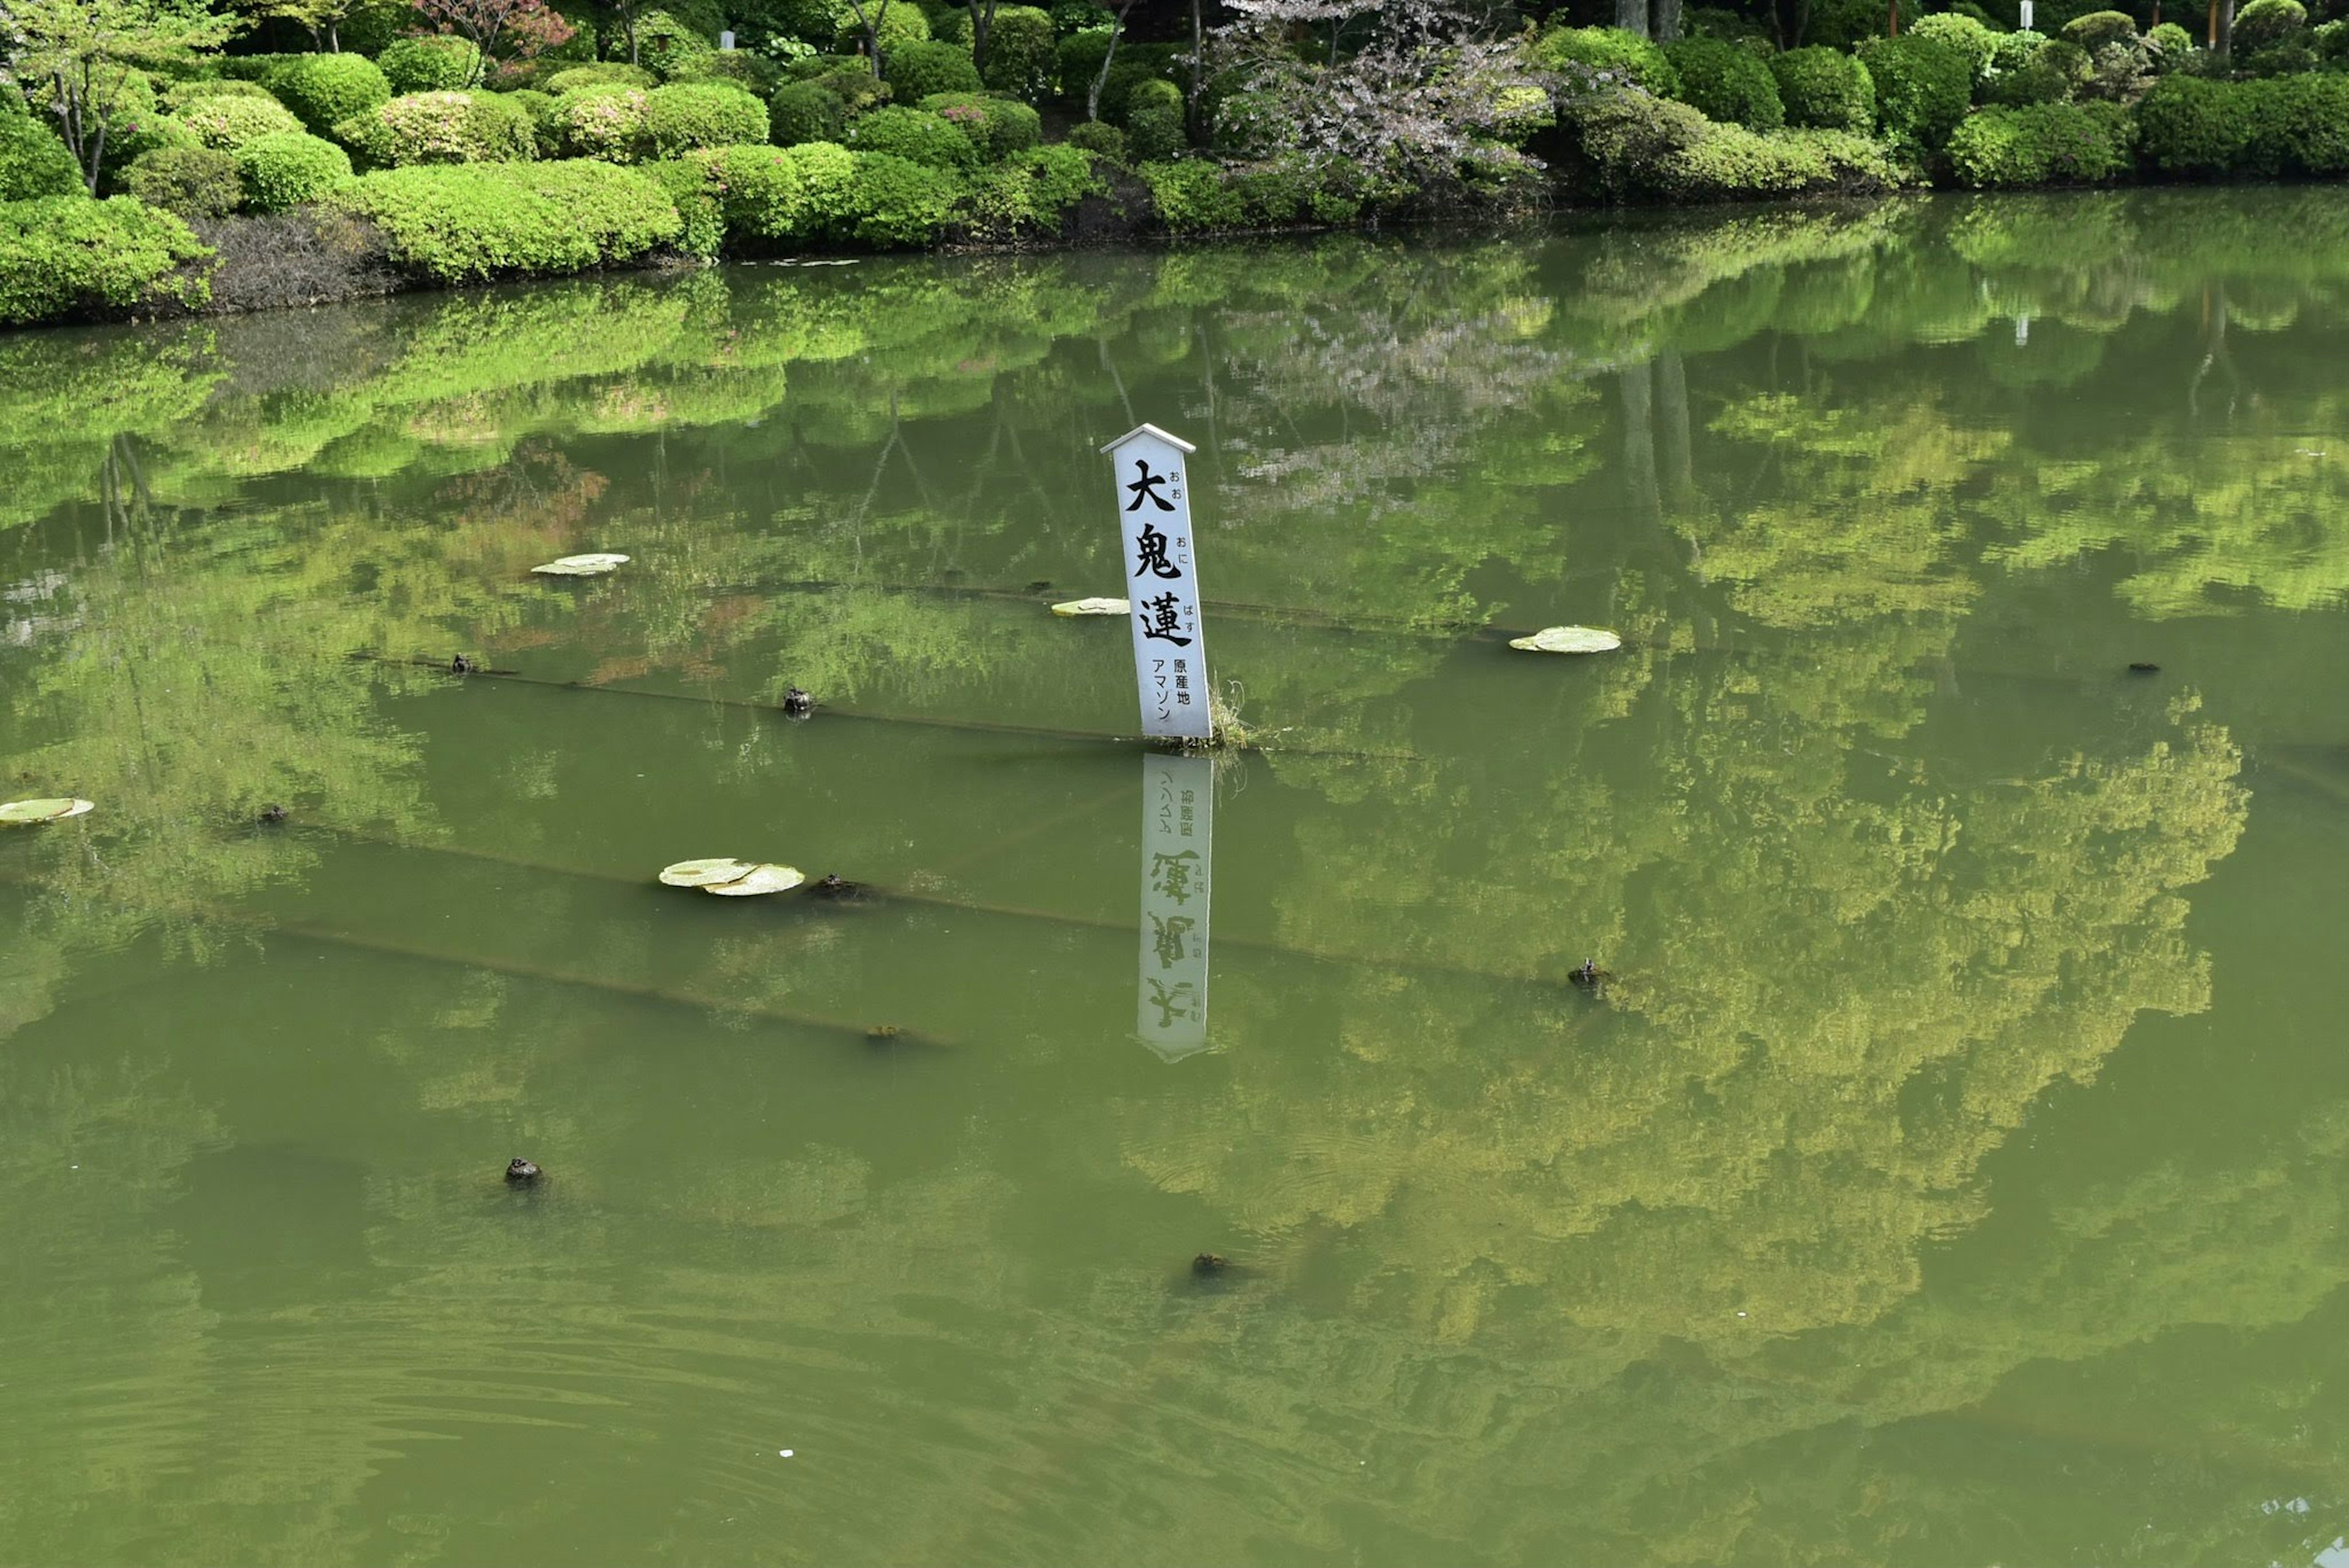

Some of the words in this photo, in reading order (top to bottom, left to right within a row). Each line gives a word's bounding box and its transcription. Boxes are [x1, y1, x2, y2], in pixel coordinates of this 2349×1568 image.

[1126, 459, 1192, 647] 大鬼蓮
[1174, 659, 1190, 705] 原産地
